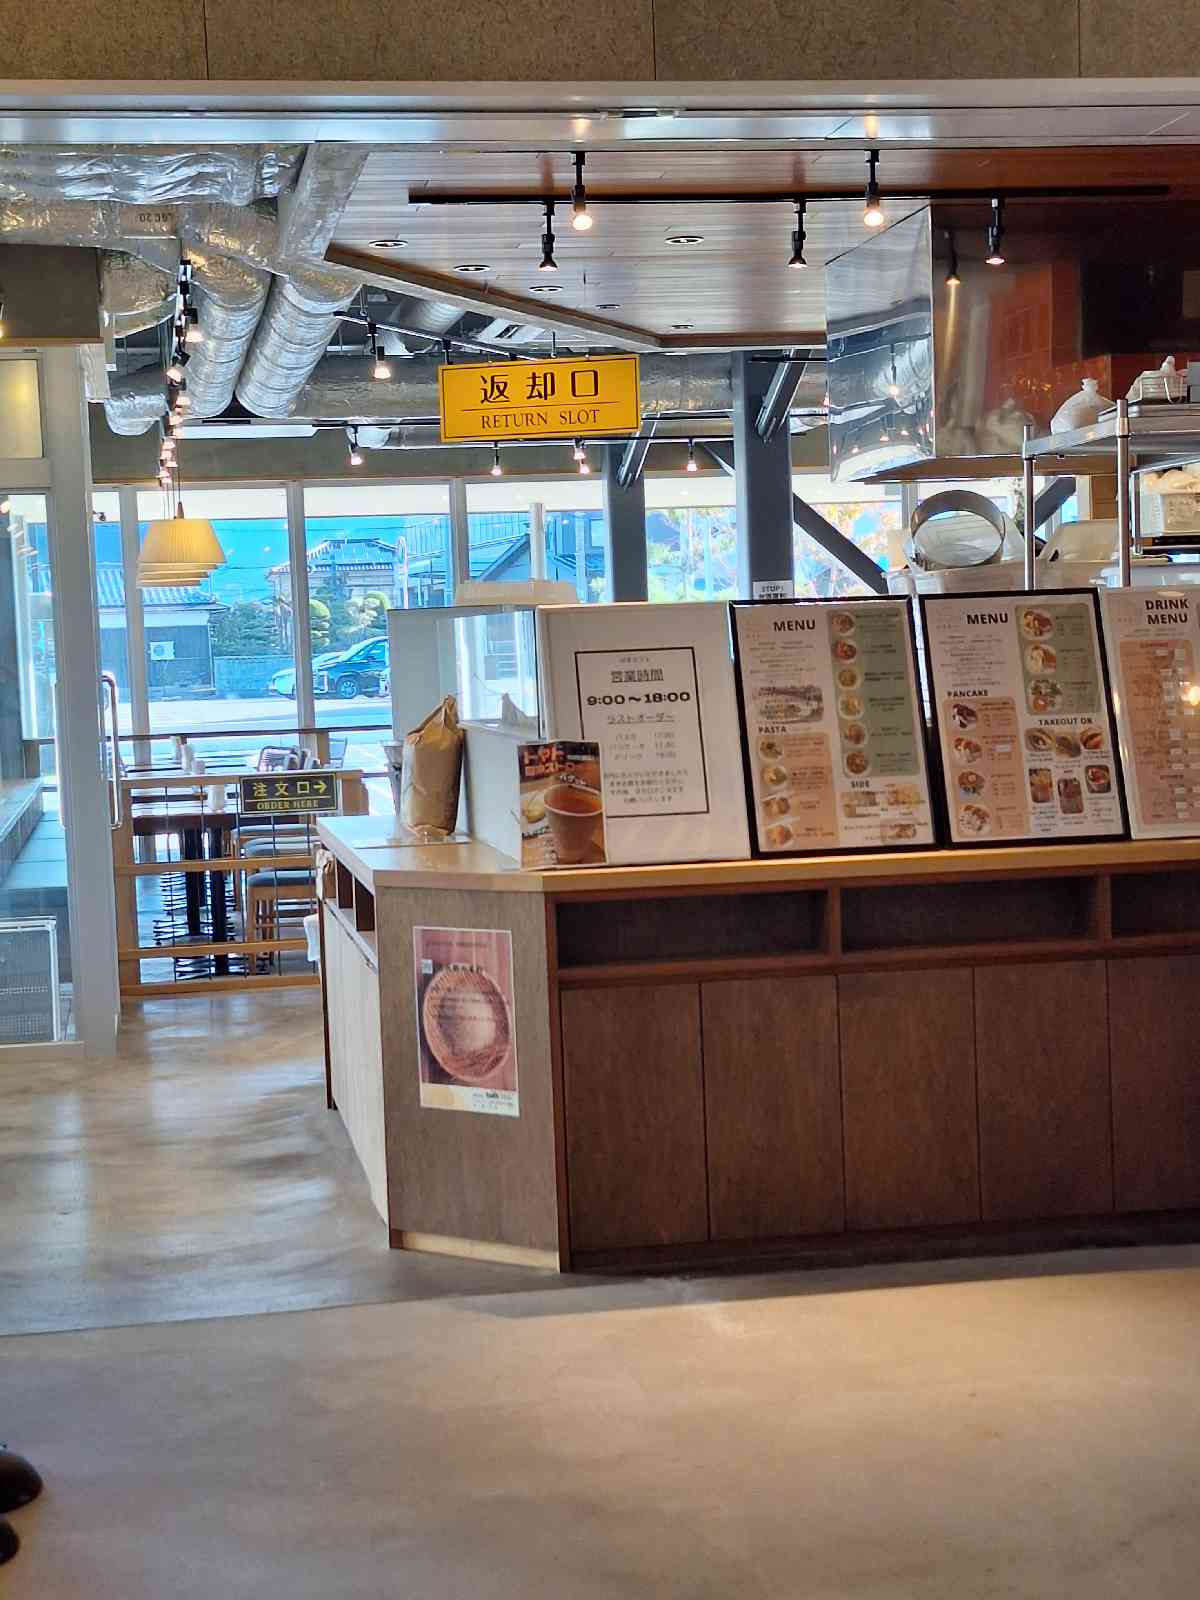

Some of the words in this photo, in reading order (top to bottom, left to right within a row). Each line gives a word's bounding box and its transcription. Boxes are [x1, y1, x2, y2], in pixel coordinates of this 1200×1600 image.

[480, 369, 599, 404] 返却口
[481, 411, 548, 429] RETURN
[559, 408, 600, 425] SLOT
[1145, 598, 1189, 611] DRINK
[965, 612, 1009, 625] MENU
[1147, 613, 1188, 625] MENU
[773, 619, 816, 632] MENU
[947, 690, 988, 698] PANCAKE
[1039, 716, 1078, 726] TAKEOUT
[758, 725, 787, 735] PASTA
[253, 782, 309, 797] 注文口
[256, 800, 289, 810] ORDER
[292, 799, 319, 809] HERE
